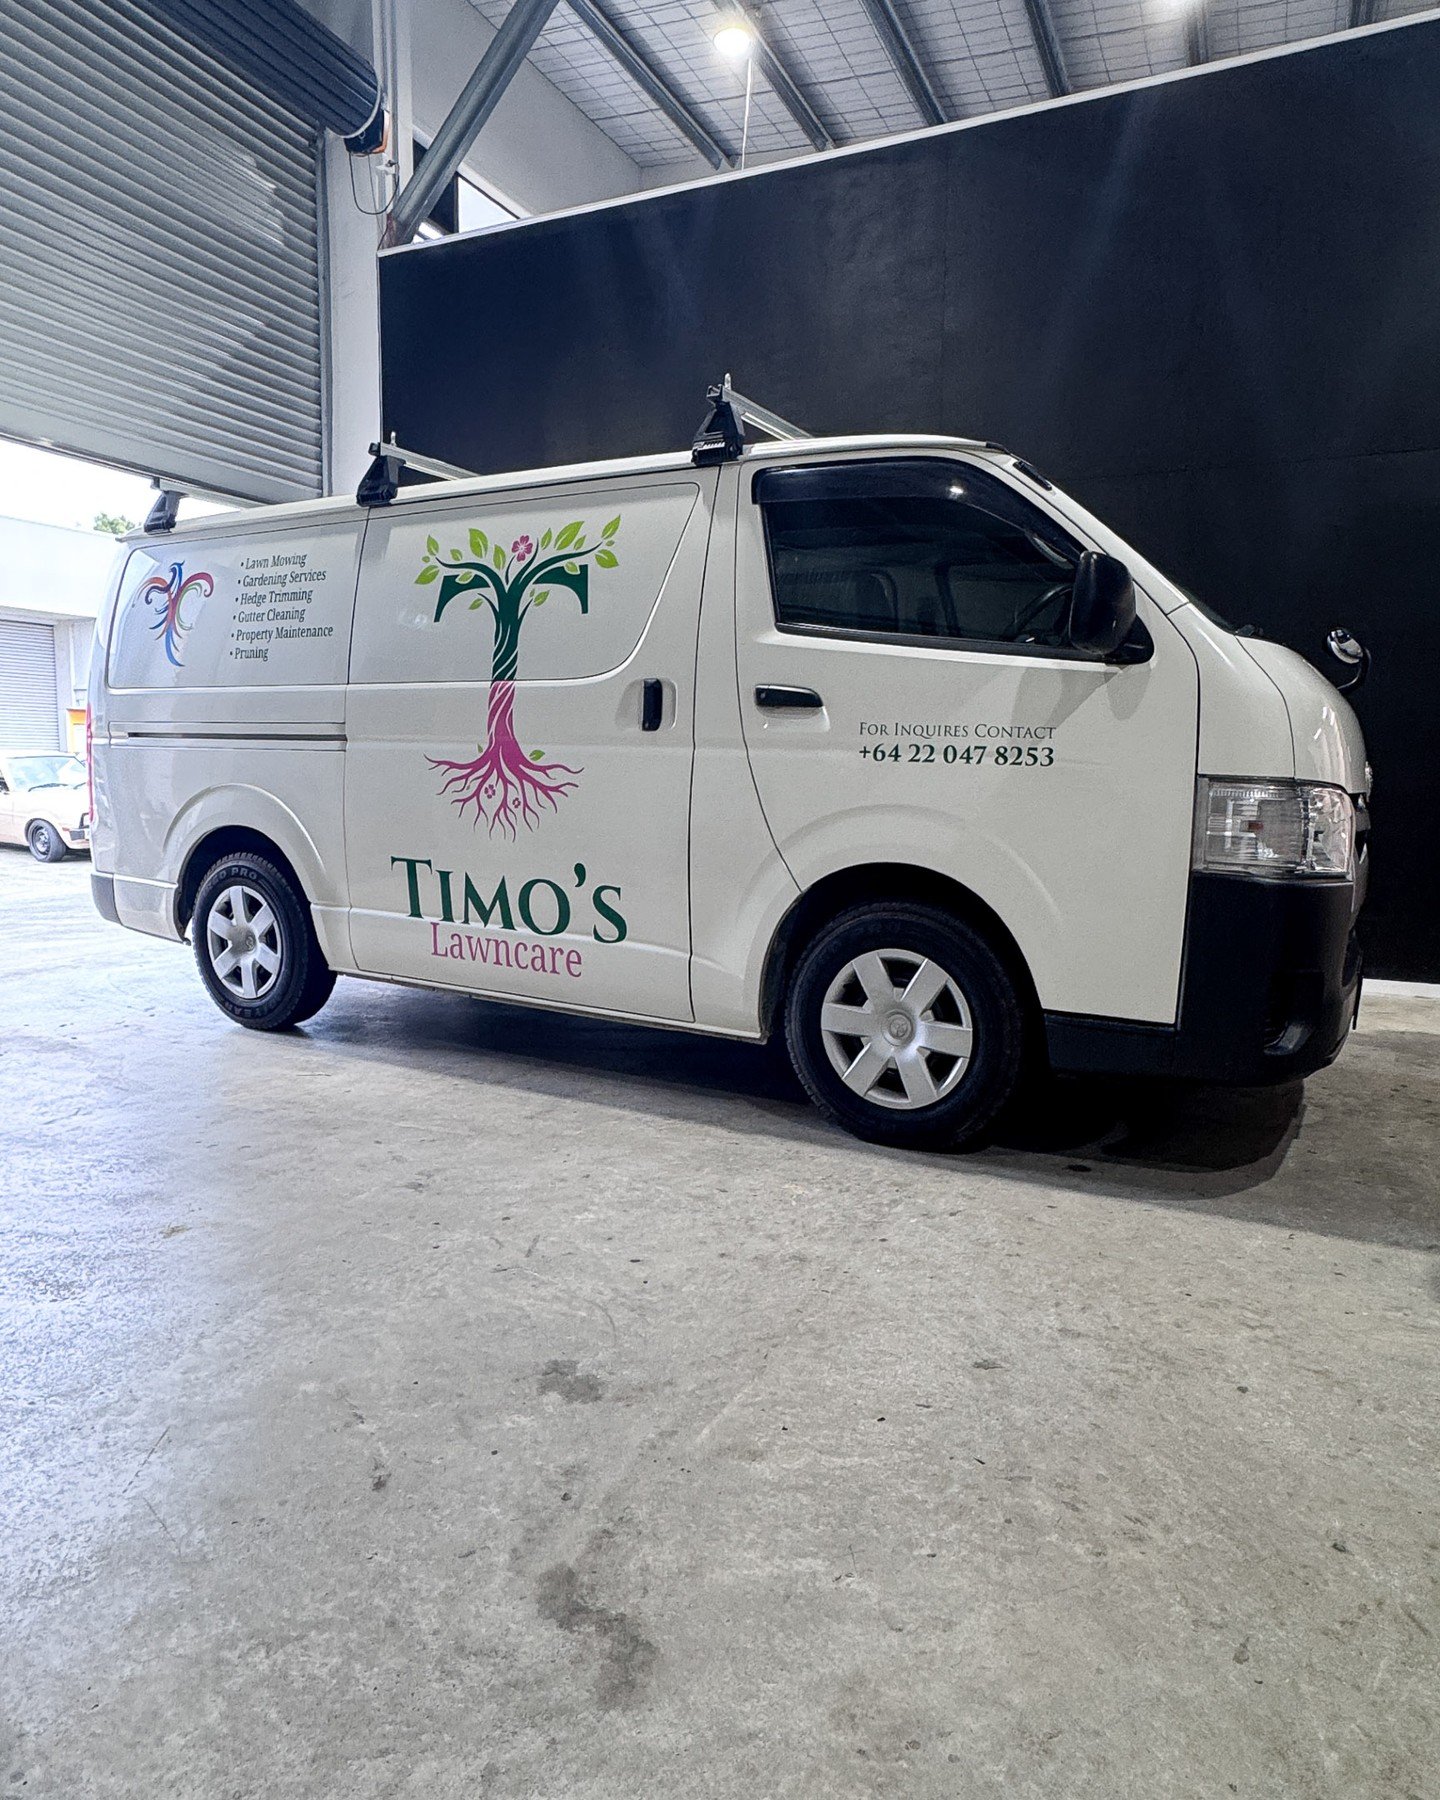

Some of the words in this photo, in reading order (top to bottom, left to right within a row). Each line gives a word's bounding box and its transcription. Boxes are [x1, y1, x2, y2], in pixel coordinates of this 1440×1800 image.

[245, 558, 269, 570] Lawn
[271, 553, 308, 568] Mowing
[243, 572, 288, 587] Gardening
[289, 569, 327, 583] Services
[240, 592, 267, 607] Hedge
[269, 588, 313, 604] Trimming
[238, 611, 266, 623] Gutter
[267, 607, 306, 623] Cleaning
[236, 629, 274, 644] Property
[275, 625, 334, 640] Maintenance
[234, 647, 269, 662] Pruning
[859, 722, 889, 736] FOR
[894, 723, 969, 740] INQUIRES
[974, 723, 1057, 740] CONTACT
[859, 742, 902, 762] +64
[907, 743, 936, 763] 22
[942, 744, 988, 765] 047
[993, 745, 1055, 767] 8253
[390, 855, 628, 944] TIMO'S
[430, 921, 583, 978] Lawncare
